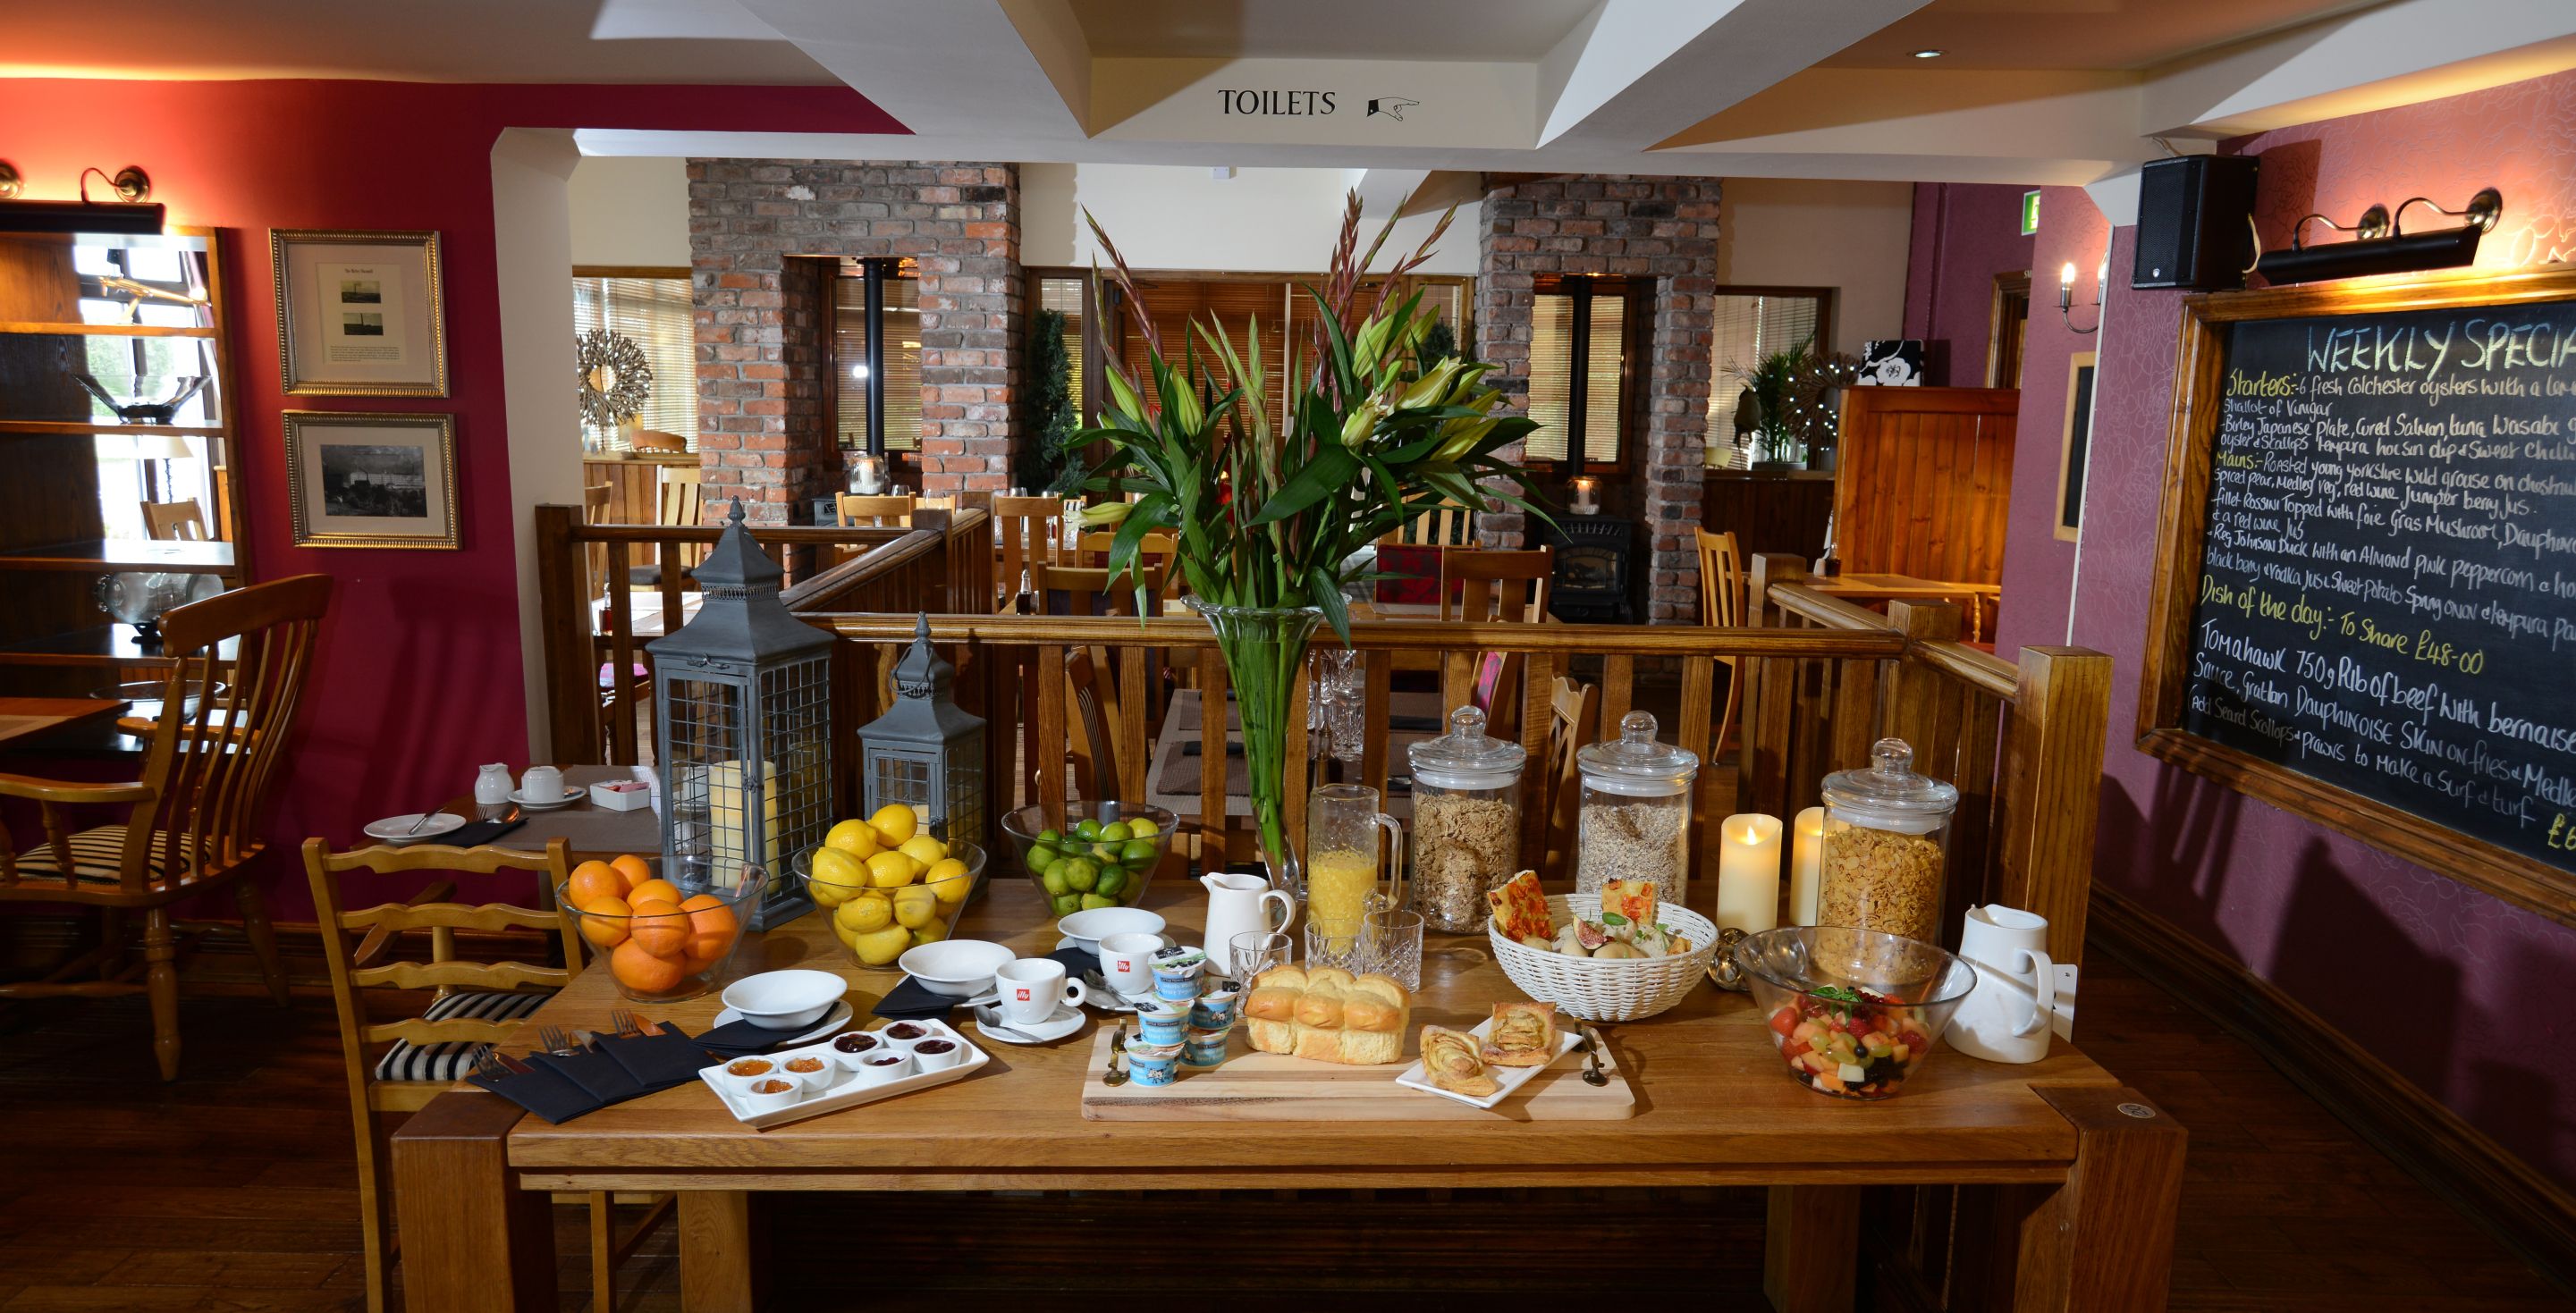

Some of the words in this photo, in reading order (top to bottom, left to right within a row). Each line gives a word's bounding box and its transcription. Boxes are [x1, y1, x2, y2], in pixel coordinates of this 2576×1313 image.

[1217, 89, 1336, 115] TOILETS
[2308, 321, 2456, 382] WEEKLY
[2310, 375, 2343, 401] fresh
[2420, 373, 2478, 407] oysters
[2481, 374, 2524, 397] with
[2530, 381, 2541, 397] a
[2268, 399, 2283, 417] of
[2257, 417, 2311, 439] Japanese
[2311, 461, 2343, 485] young
[2441, 470, 2490, 493] grouse
[2495, 474, 2514, 492] on
[2222, 513, 2231, 523] a
[2277, 538, 2308, 557] Duck
[2340, 549, 2356, 562] an
[2200, 574, 2233, 606] Dish
[2237, 586, 2256, 618] of
[2260, 591, 2286, 620] the
[2340, 610, 2355, 635] To
[2359, 618, 2408, 654] Share
[2415, 629, 2484, 675] £48-00
[2201, 618, 2286, 672] Tomahawk
[2337, 656, 2368, 692] Rib
[2369, 671, 2394, 706] of
[2391, 675, 2437, 726] beef
[2354, 743, 2369, 766] to
[2423, 772, 2434, 787] a
[2469, 739, 2510, 780] fries
[1118, 961, 1129, 972] illy
[1017, 989, 1029, 999] illy
